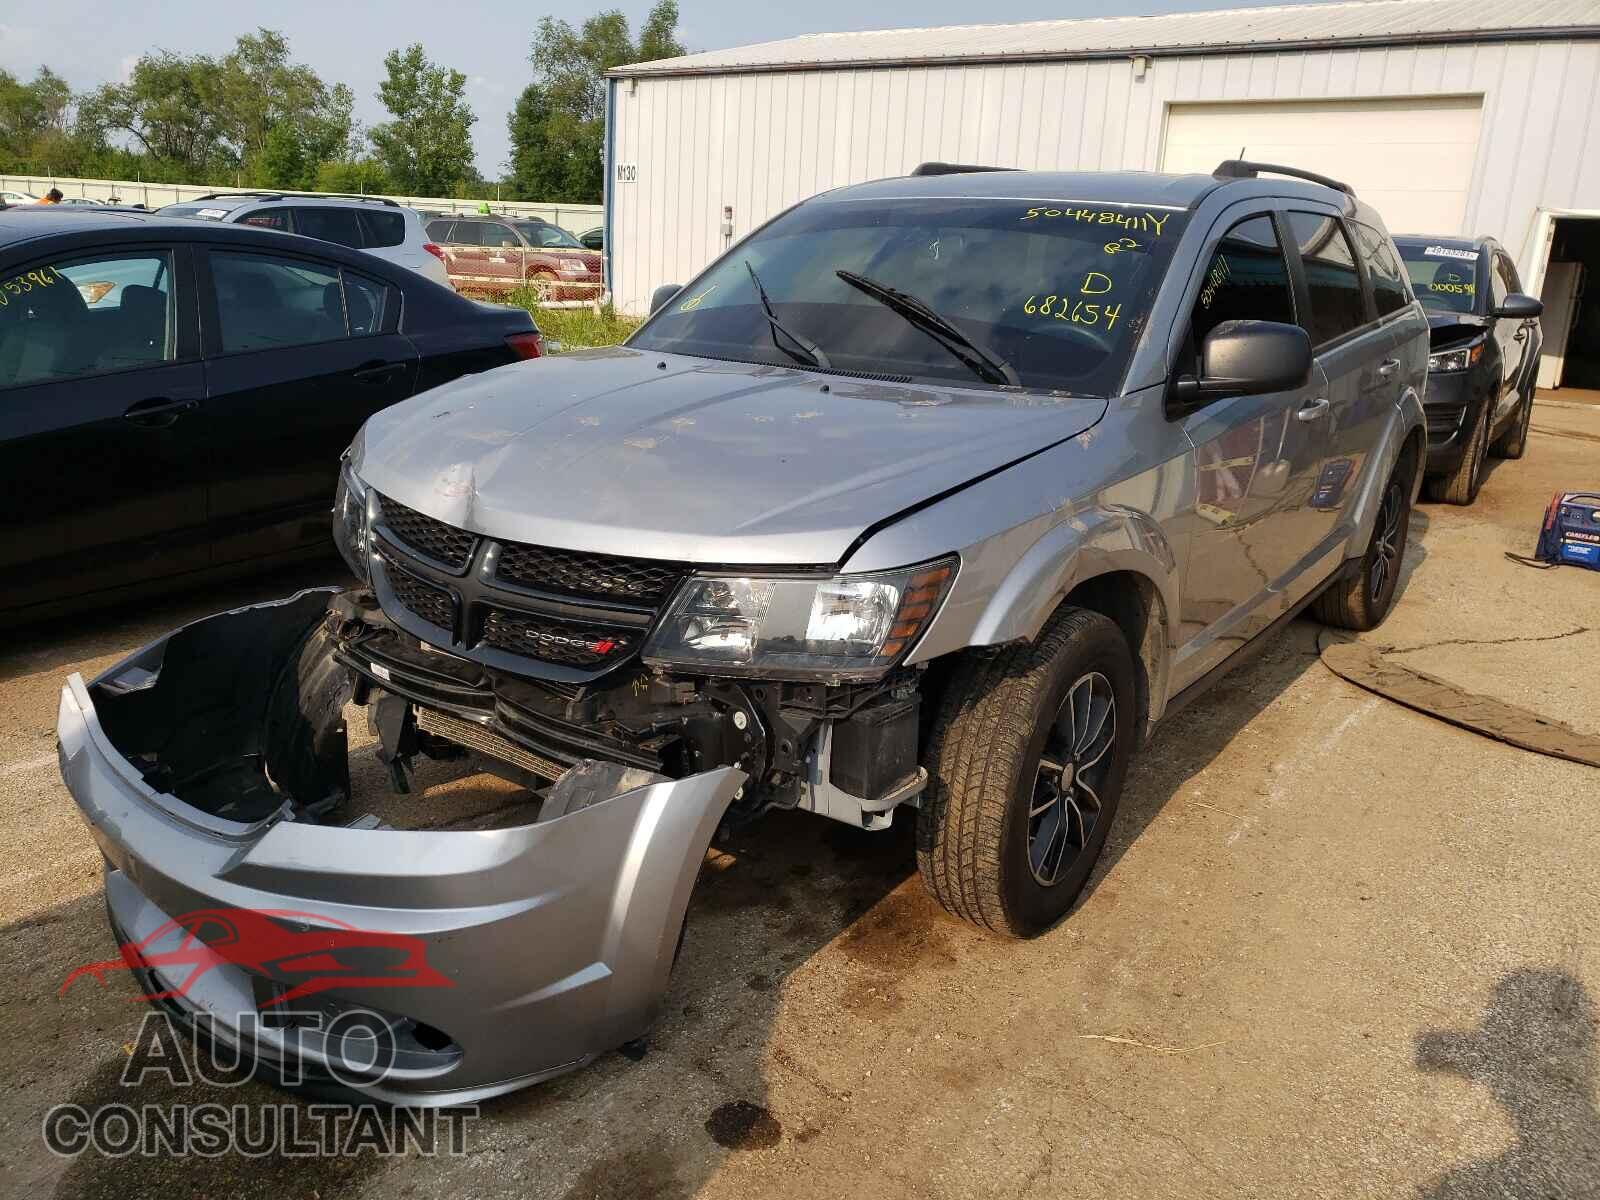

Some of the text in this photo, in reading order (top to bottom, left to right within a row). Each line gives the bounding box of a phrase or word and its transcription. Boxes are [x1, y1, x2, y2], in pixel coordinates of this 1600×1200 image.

[1080, 271, 1113, 295] D
[1023, 295, 1123, 331] 682654
[525, 629, 600, 649] DODGE
